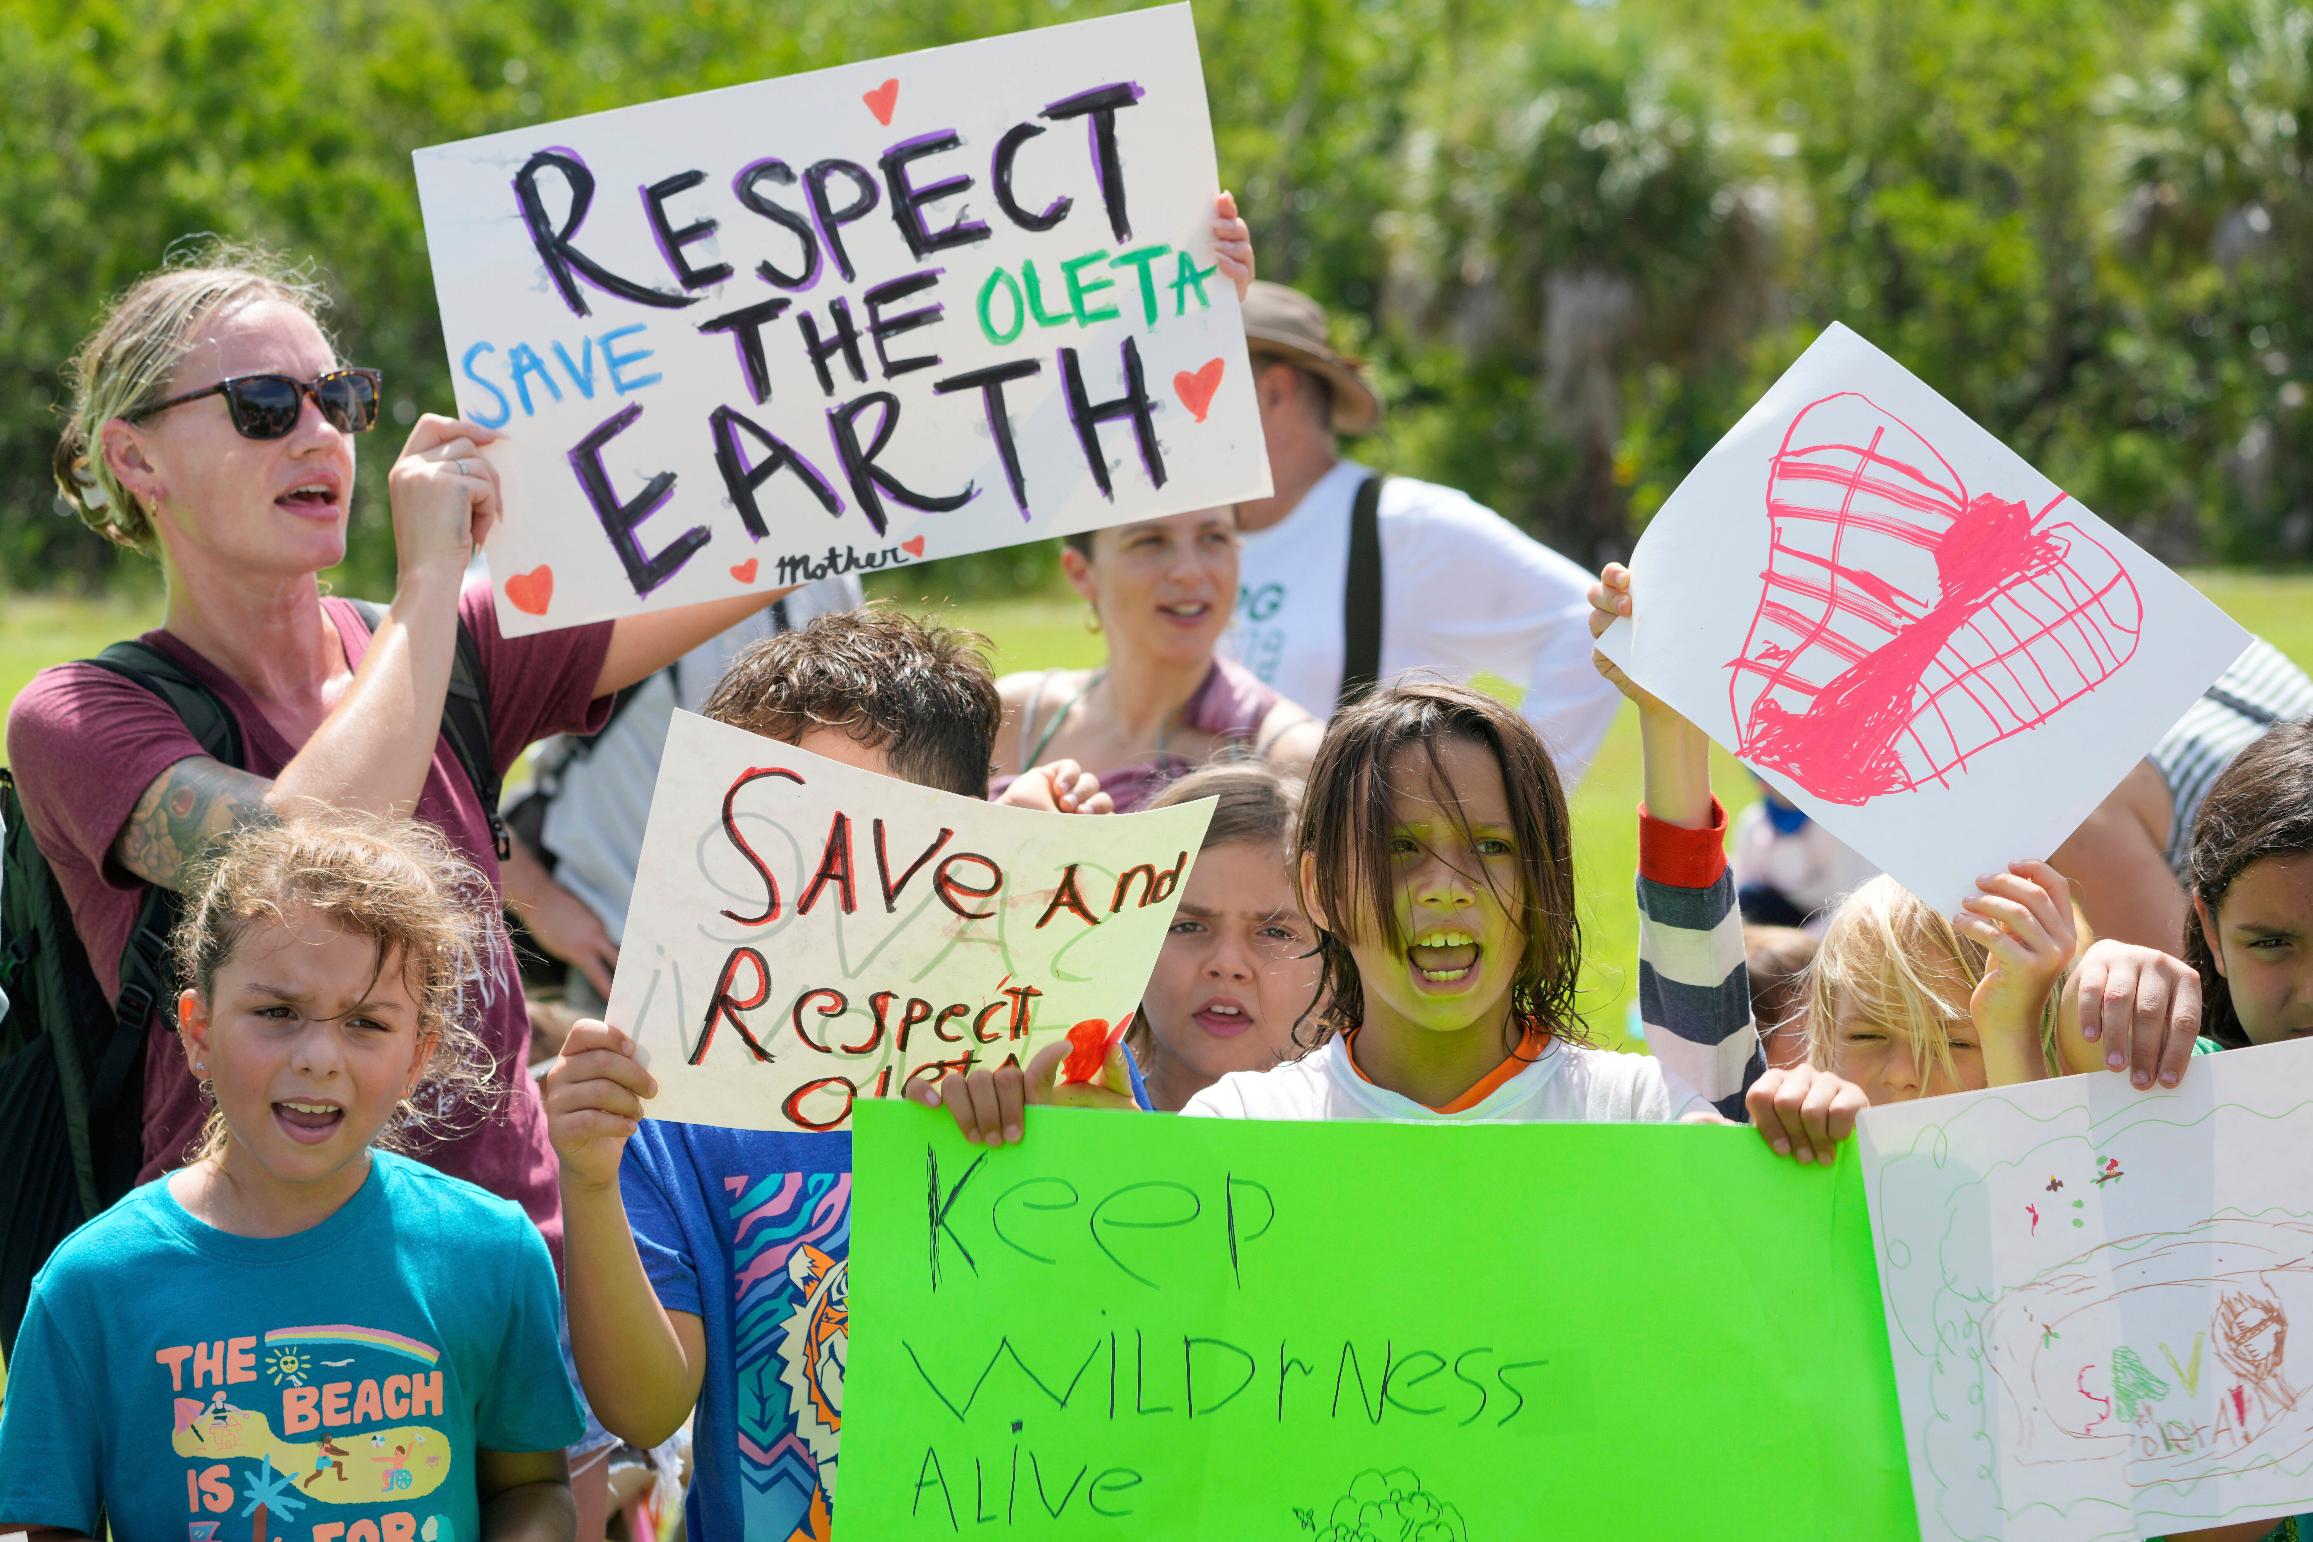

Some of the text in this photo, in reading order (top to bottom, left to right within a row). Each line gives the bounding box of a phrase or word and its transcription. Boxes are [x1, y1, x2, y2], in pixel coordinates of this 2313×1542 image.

[511, 80, 1145, 319] RESPECT
[696, 266, 946, 406] THE
[975, 243, 1219, 347] OLETA
[461, 322, 663, 430] SAVE
[566, 335, 1168, 601] EARTH
[155, 1335, 258, 1392] THE
[282, 1370, 445, 1437] BEACH
[186, 1463, 236, 1514] IS
